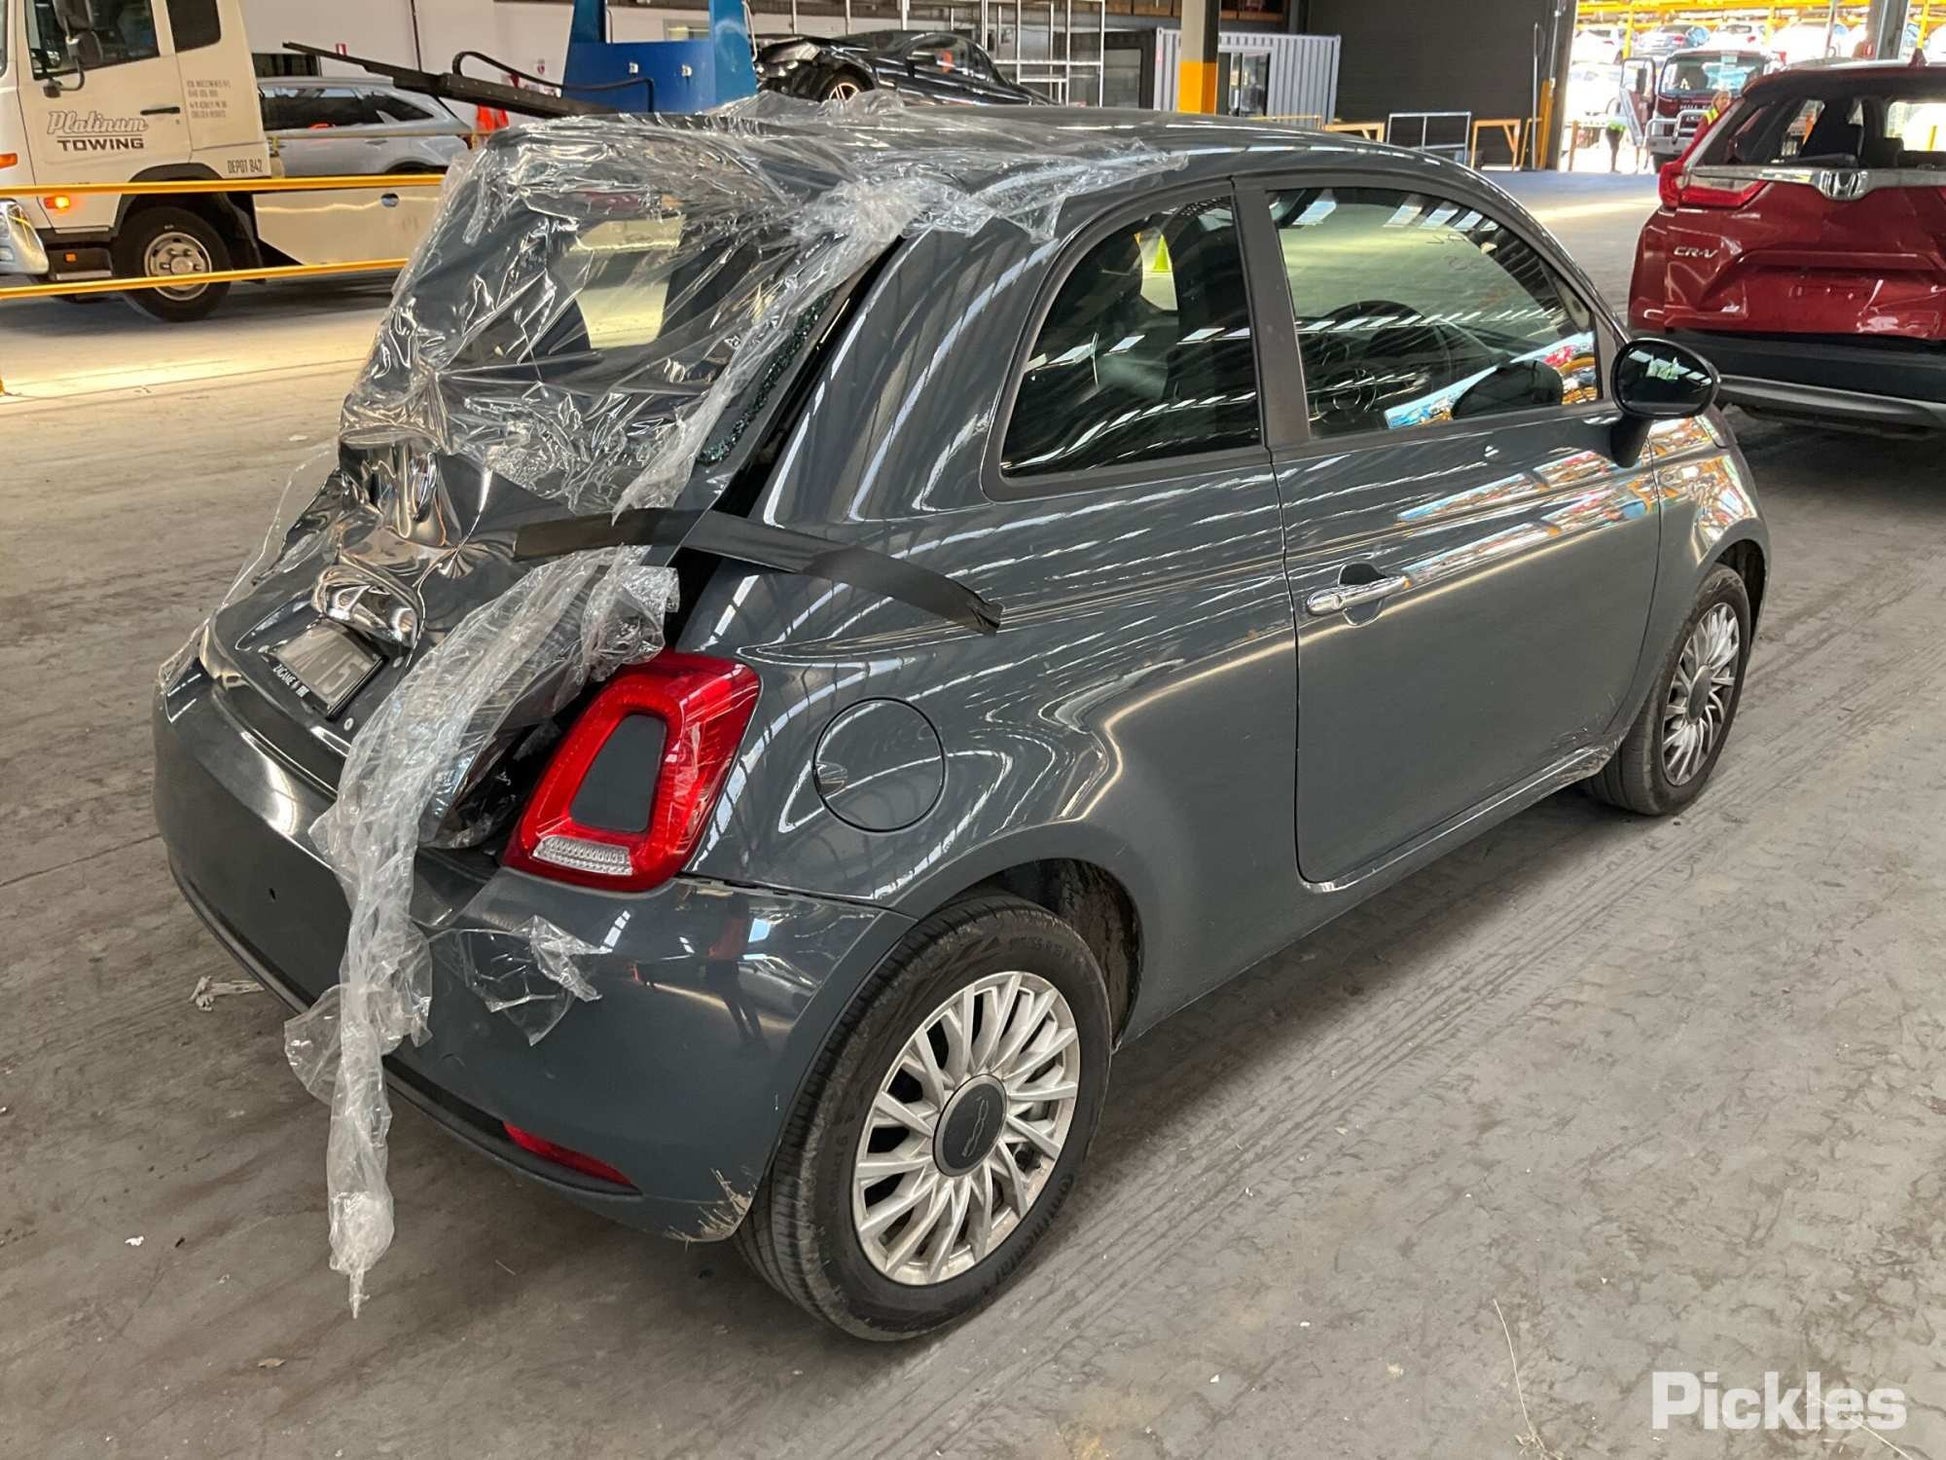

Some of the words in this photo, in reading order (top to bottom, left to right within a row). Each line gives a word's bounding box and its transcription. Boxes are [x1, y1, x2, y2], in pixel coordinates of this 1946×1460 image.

[46, 110, 149, 135] Platinum
[57, 138, 144, 151] TOWING
[227, 159, 248, 173] DEPOT
[1673, 246, 1718, 258] CR-V
